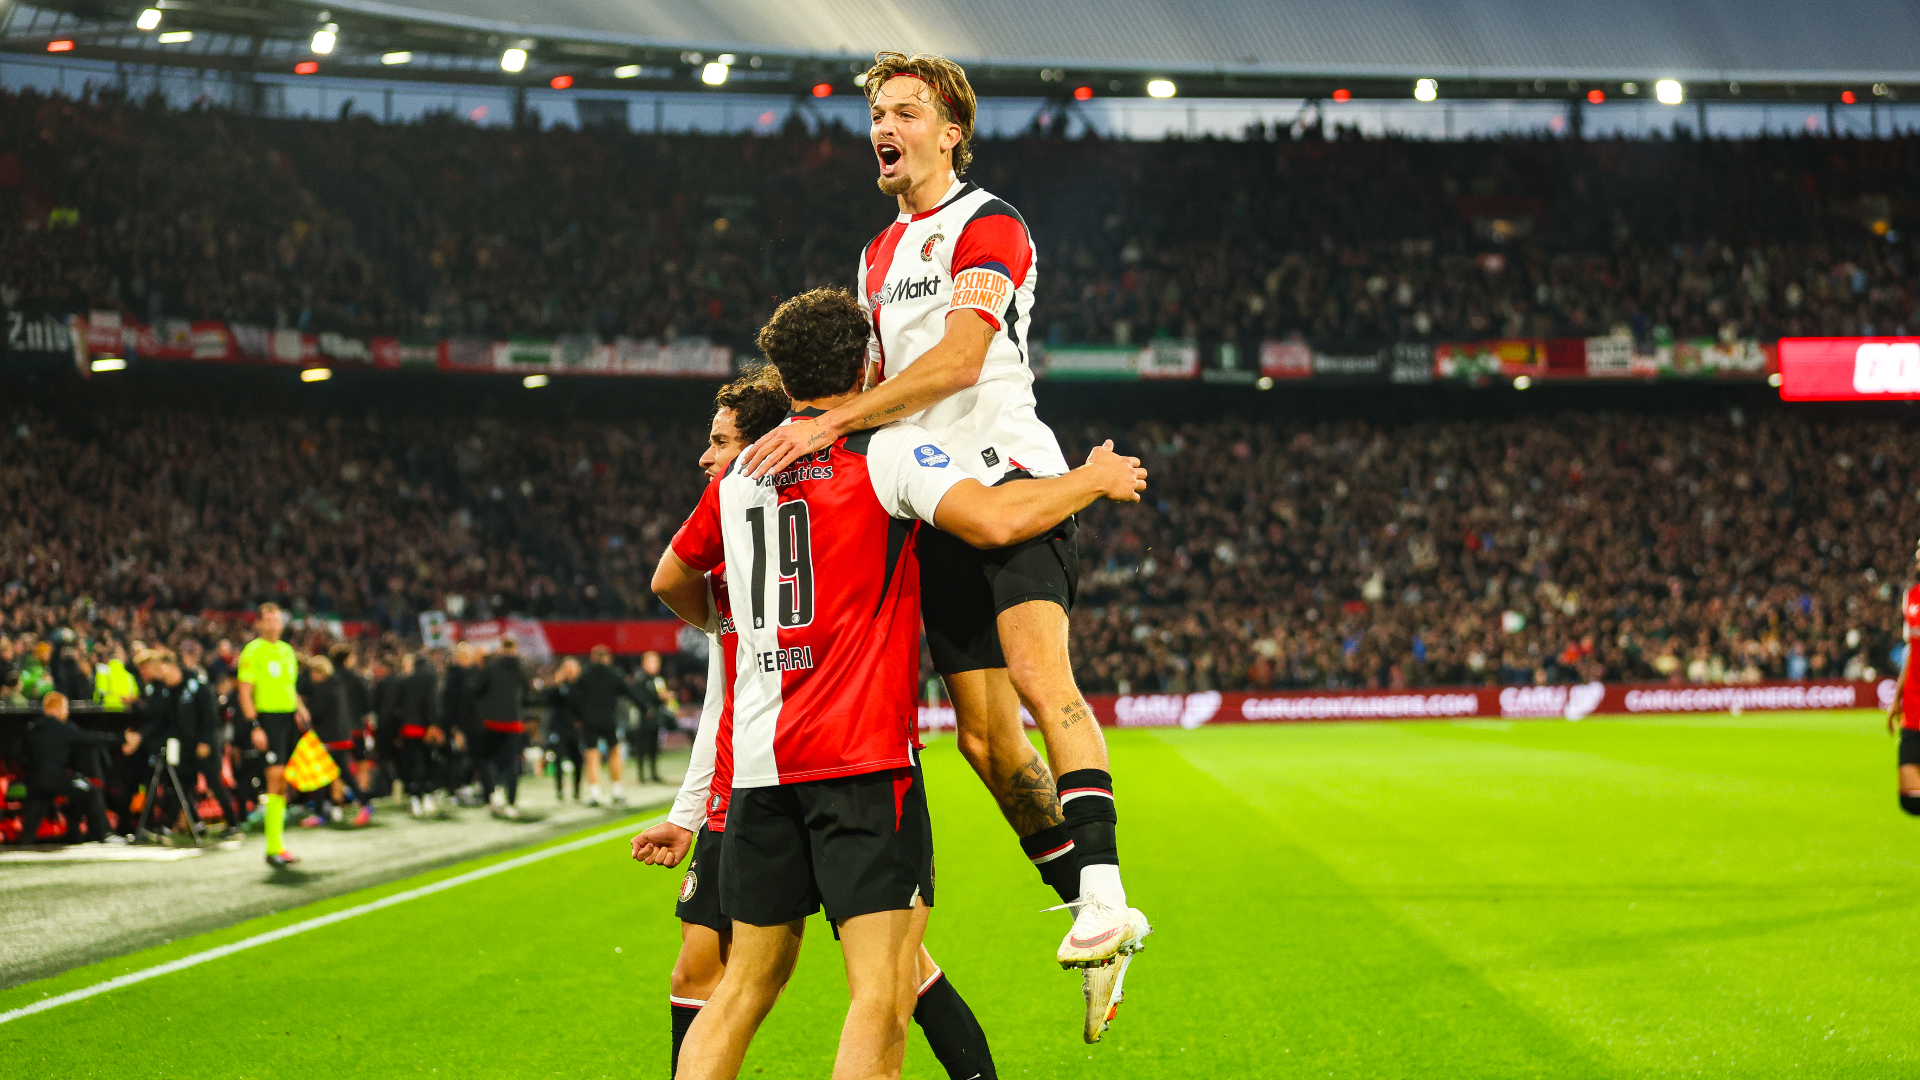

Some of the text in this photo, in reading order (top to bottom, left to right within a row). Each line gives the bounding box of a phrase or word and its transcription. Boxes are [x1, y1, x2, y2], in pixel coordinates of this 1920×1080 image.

[889, 275, 941, 303] Markt
[954, 271, 1008, 297] #SCHEIDS
[950, 289, 1003, 314] BEDANKT!
[745, 499, 814, 629] 19
[756, 646, 814, 674] FERRI
